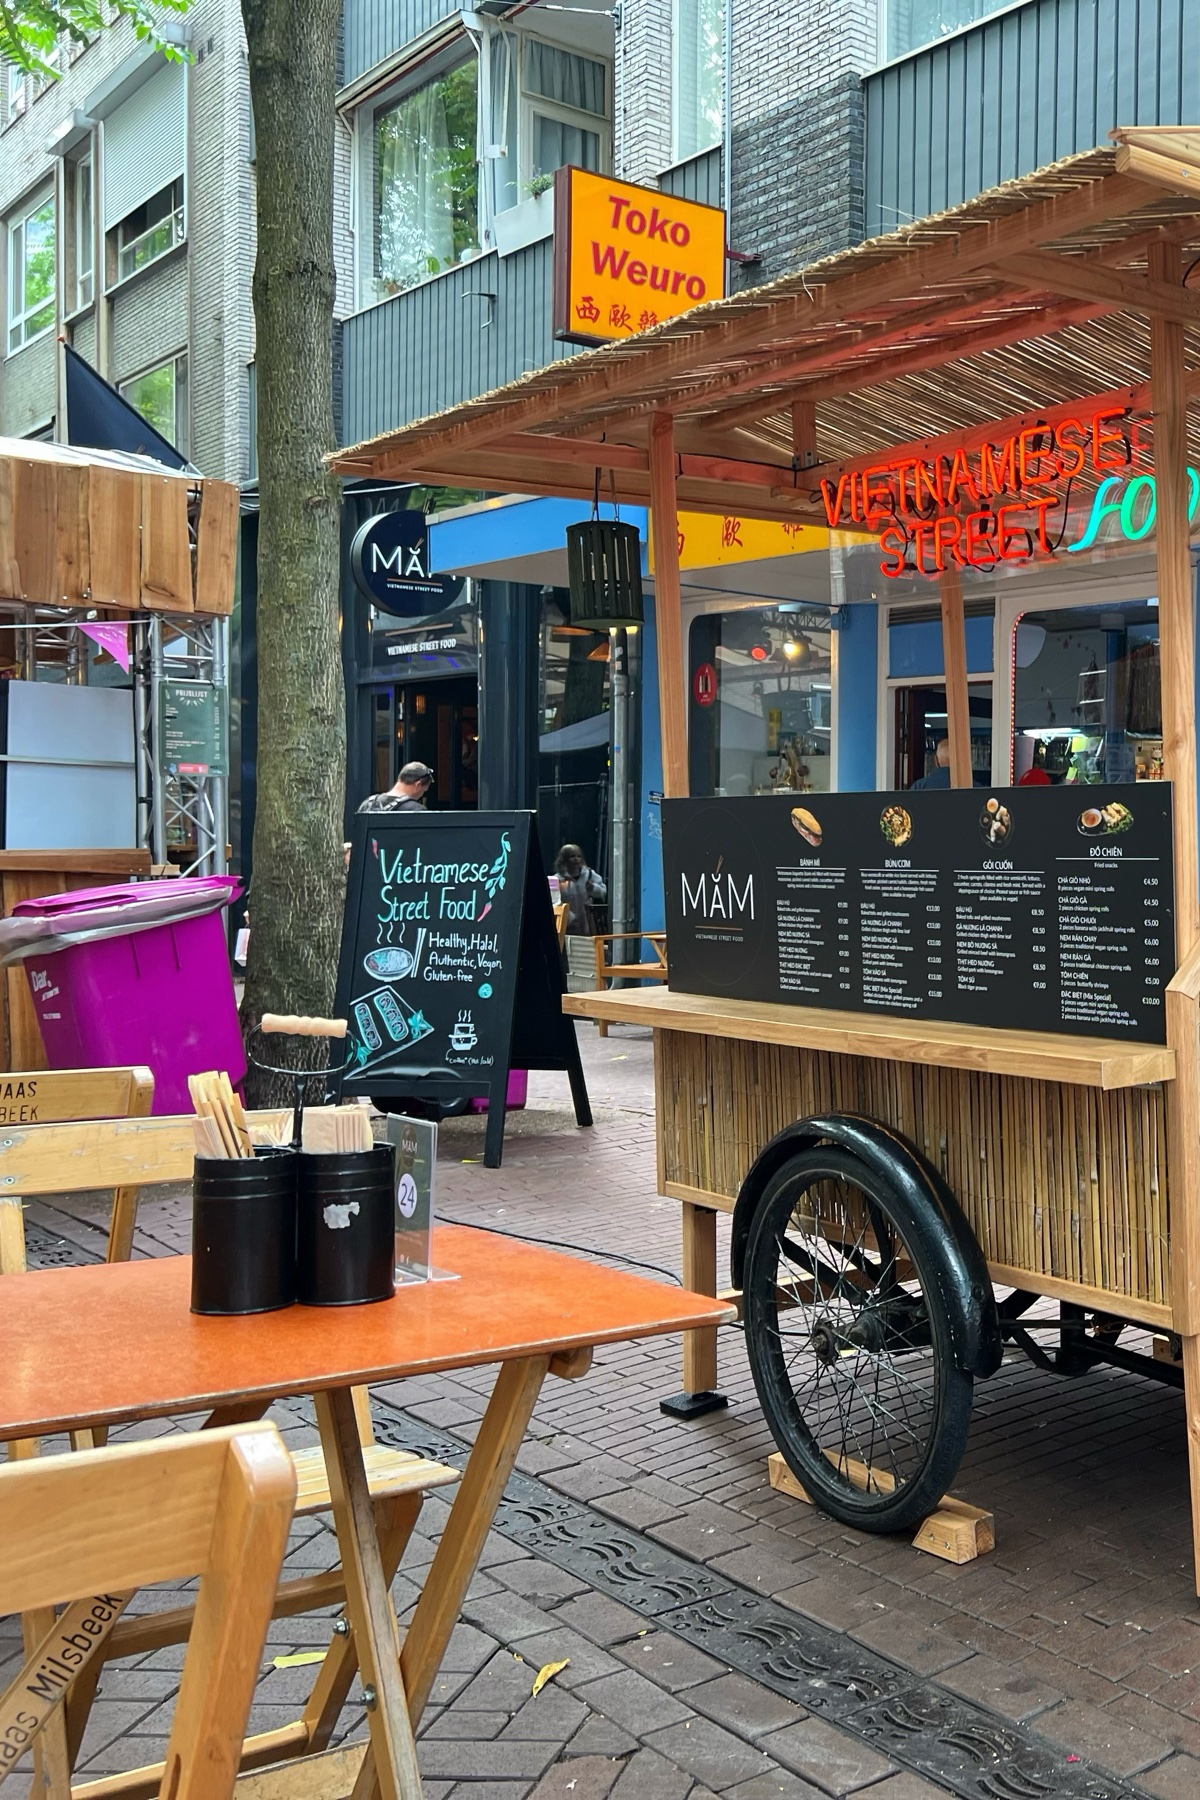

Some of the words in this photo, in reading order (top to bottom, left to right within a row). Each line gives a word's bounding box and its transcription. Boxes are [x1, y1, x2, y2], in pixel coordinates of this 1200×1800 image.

[609, 195, 690, 247] Toko
[591, 240, 706, 300] Weuro
[820, 407, 1130, 527] VIETNAMESE
[880, 497, 1060, 580] STREET
[387, 643, 419, 656] VIETNAMESE
[419, 640, 440, 652] STREET
[440, 638, 457, 649] FOOD
[175, 689, 208, 698] PRIJSLIJST
[380, 847, 489, 884] Vietnamese
[378, 885, 431, 923] Street
[439, 887, 477, 921] Food
[423, 967, 473, 982] Gluten-free
[429, 951, 477, 969] Authentic,
[0, 1081, 37, 1100] AAS
[400, 1183, 415, 1209] 24
[26, 1593, 124, 1701] Milsbeek
